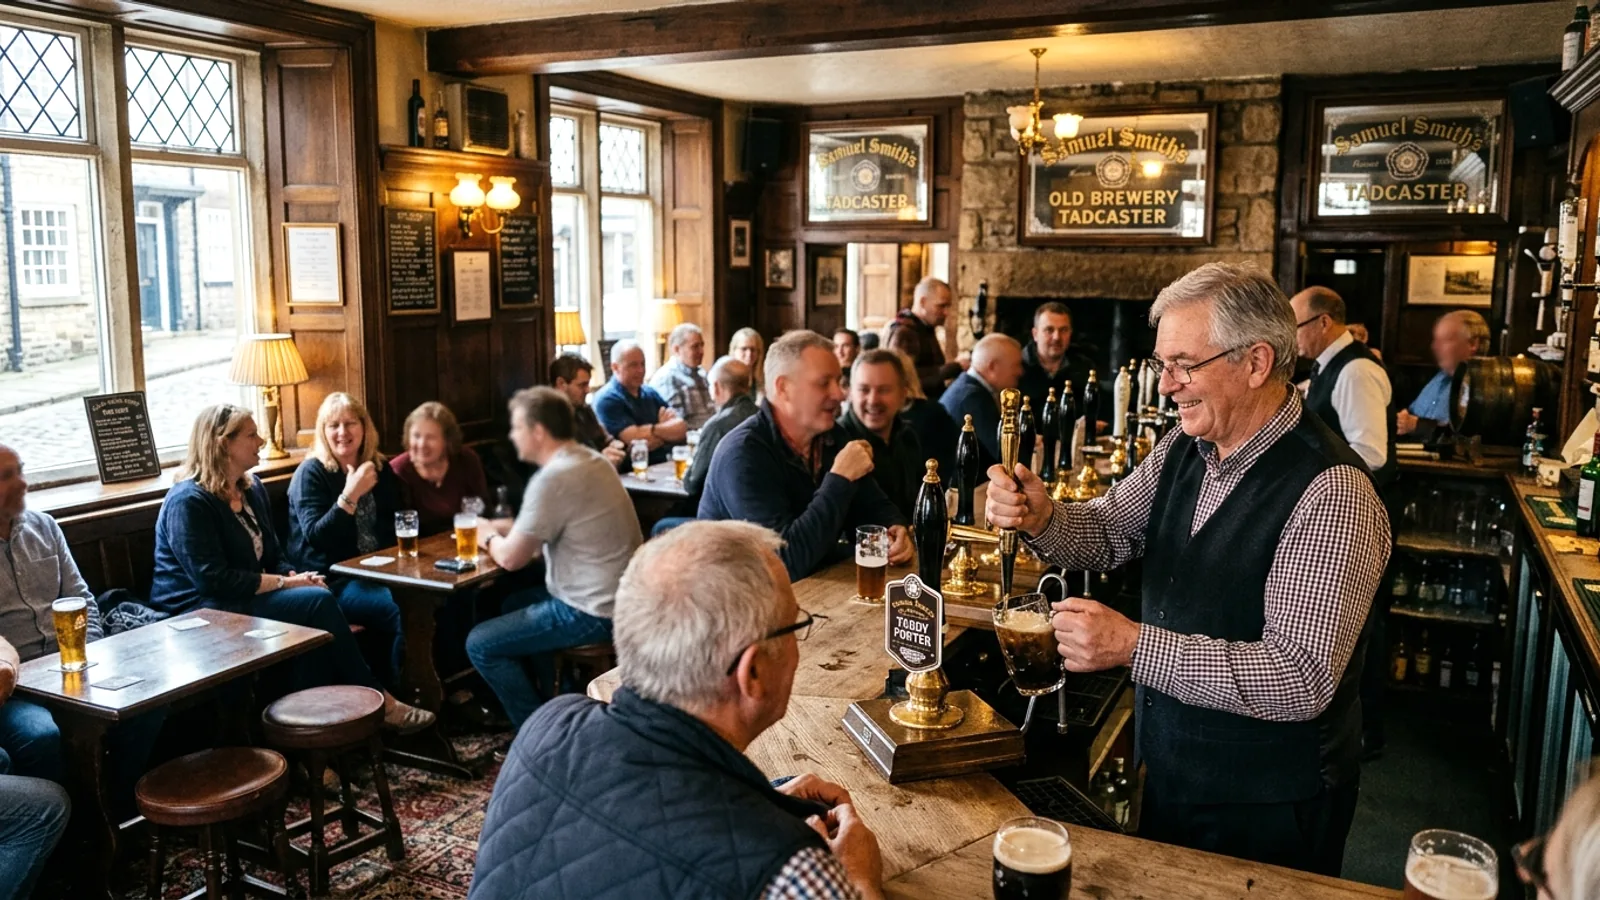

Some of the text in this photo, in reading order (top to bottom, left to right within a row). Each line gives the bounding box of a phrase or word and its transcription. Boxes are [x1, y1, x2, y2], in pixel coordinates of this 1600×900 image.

[1119, 126, 1189, 164] Smith's
[1333, 116, 1483, 155] Samuel Smith's
[817, 138, 917, 171] Samuel Smith's
[826, 194, 909, 209] TADCASTER
[1049, 189, 1178, 206] OLD BREWERY
[1345, 183, 1468, 201] TADCASTER
[1059, 209, 1167, 224] TADCASTER
[893, 627, 932, 647] PORTER
